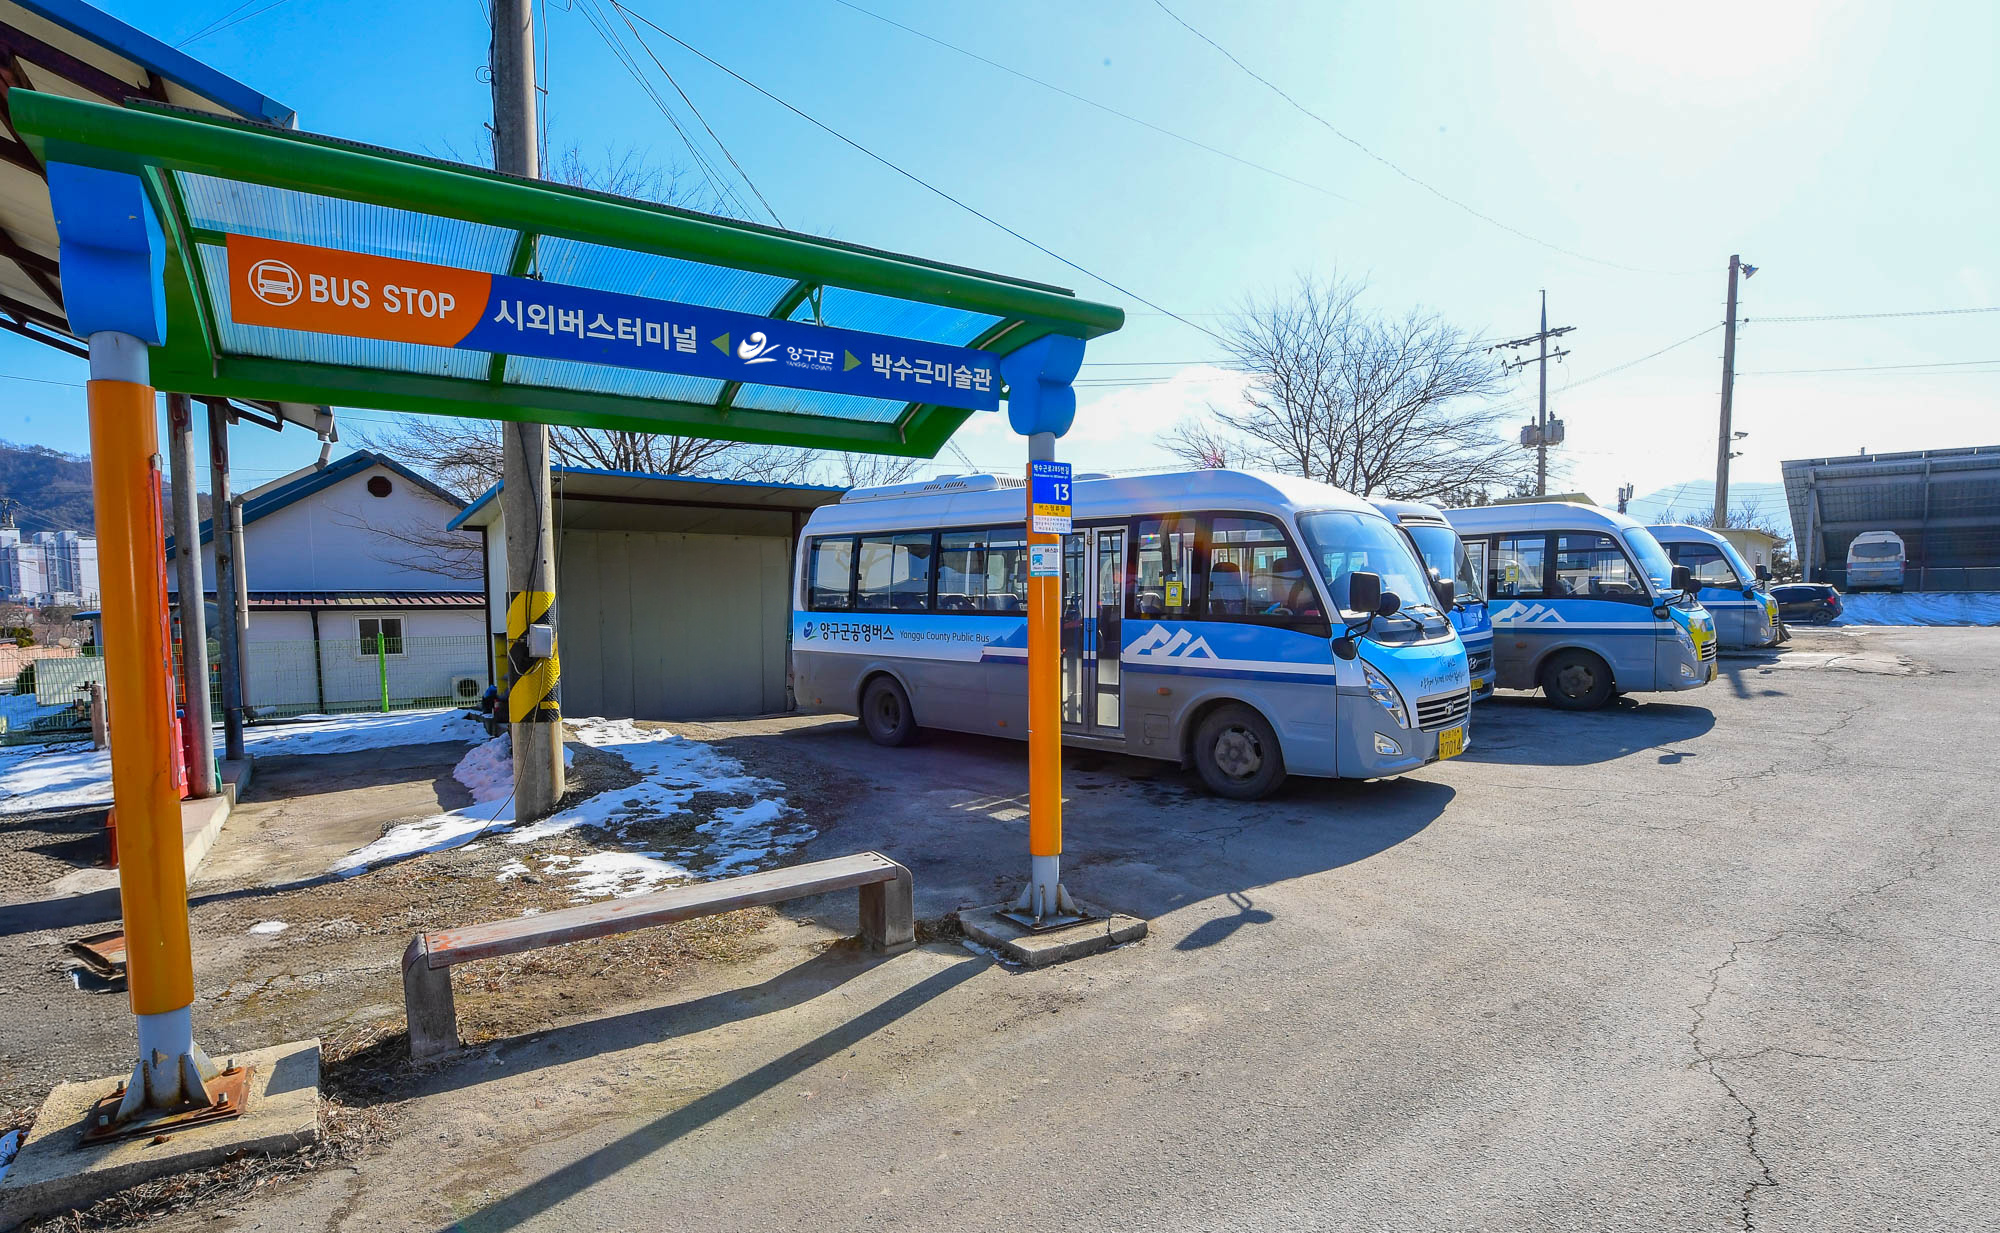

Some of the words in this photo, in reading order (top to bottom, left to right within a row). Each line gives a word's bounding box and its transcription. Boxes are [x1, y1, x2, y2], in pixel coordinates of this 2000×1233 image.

[308, 273, 371, 310] BUS
[383, 284, 456, 319] STOP
[493, 300, 698, 354] 시외버스터미널
[786, 345, 834, 366] 양구군
[786, 360, 810, 370] YANGGU
[810, 363, 833, 372] COUNTY
[871, 352, 993, 393] 박수근미술관
[1053, 483, 1070, 501] 13
[820, 622, 895, 643] 양구군공영버스
[900, 629, 925, 642] Yanggu
[926, 631, 951, 643] County
[952, 632, 974, 642] Public
[976, 633, 990, 643] Bus
